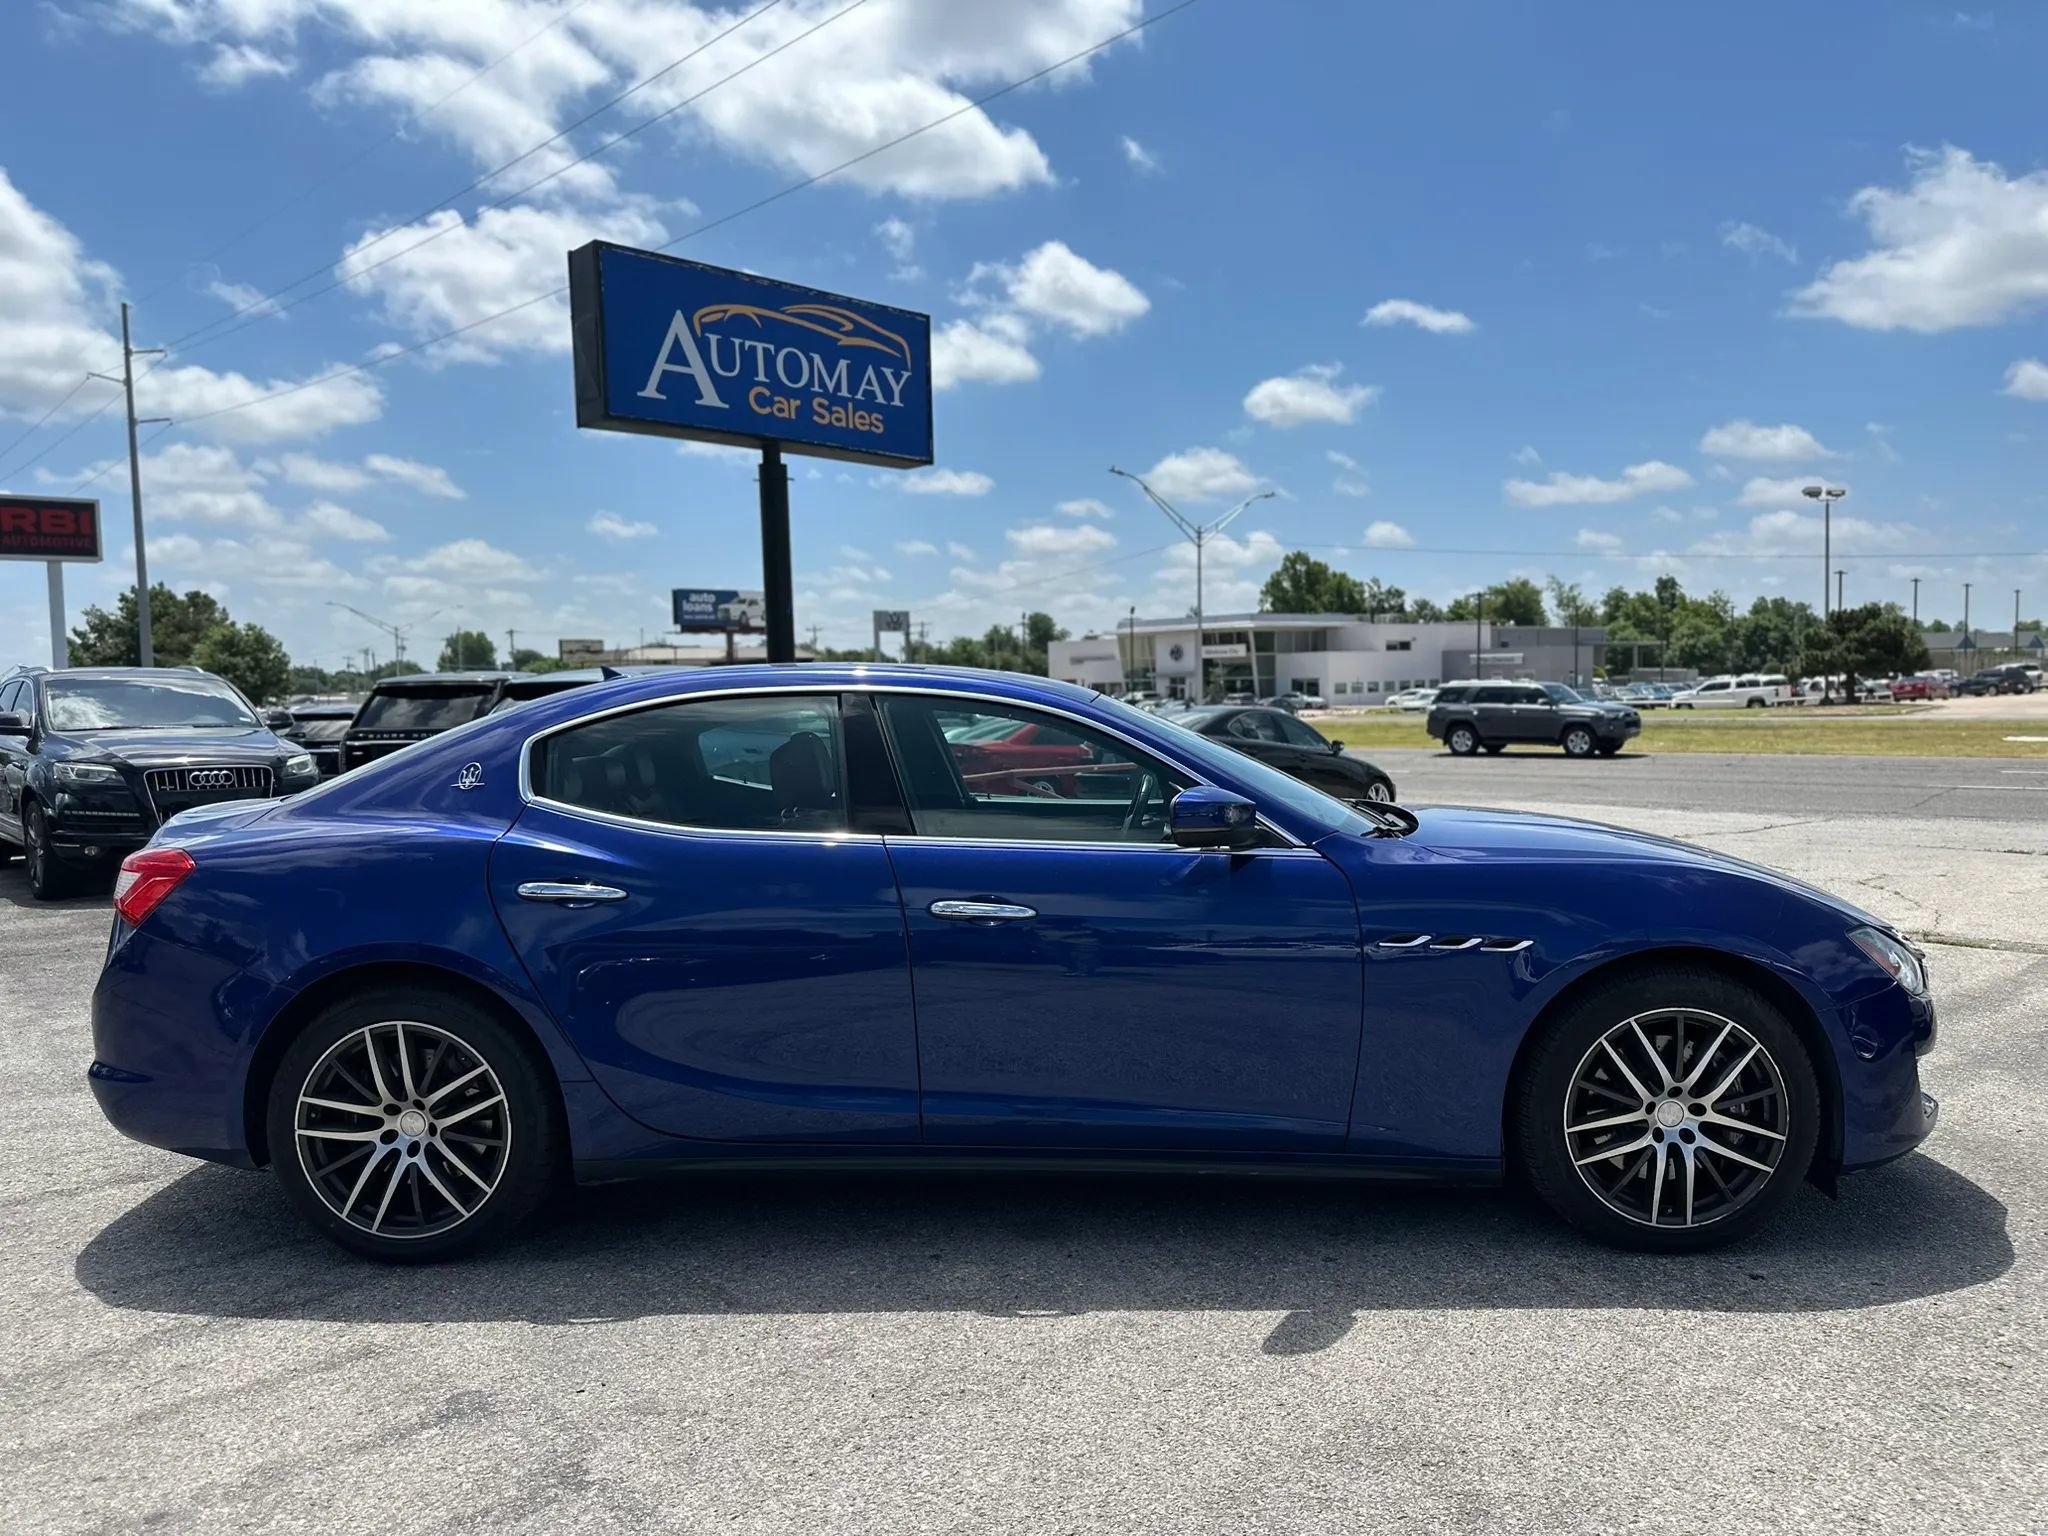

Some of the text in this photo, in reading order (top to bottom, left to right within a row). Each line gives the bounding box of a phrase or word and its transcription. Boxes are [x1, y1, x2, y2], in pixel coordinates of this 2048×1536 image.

[749, 387, 884, 434] Car Sales
[689, 592, 716, 603] auto
[683, 600, 714, 612] loans
